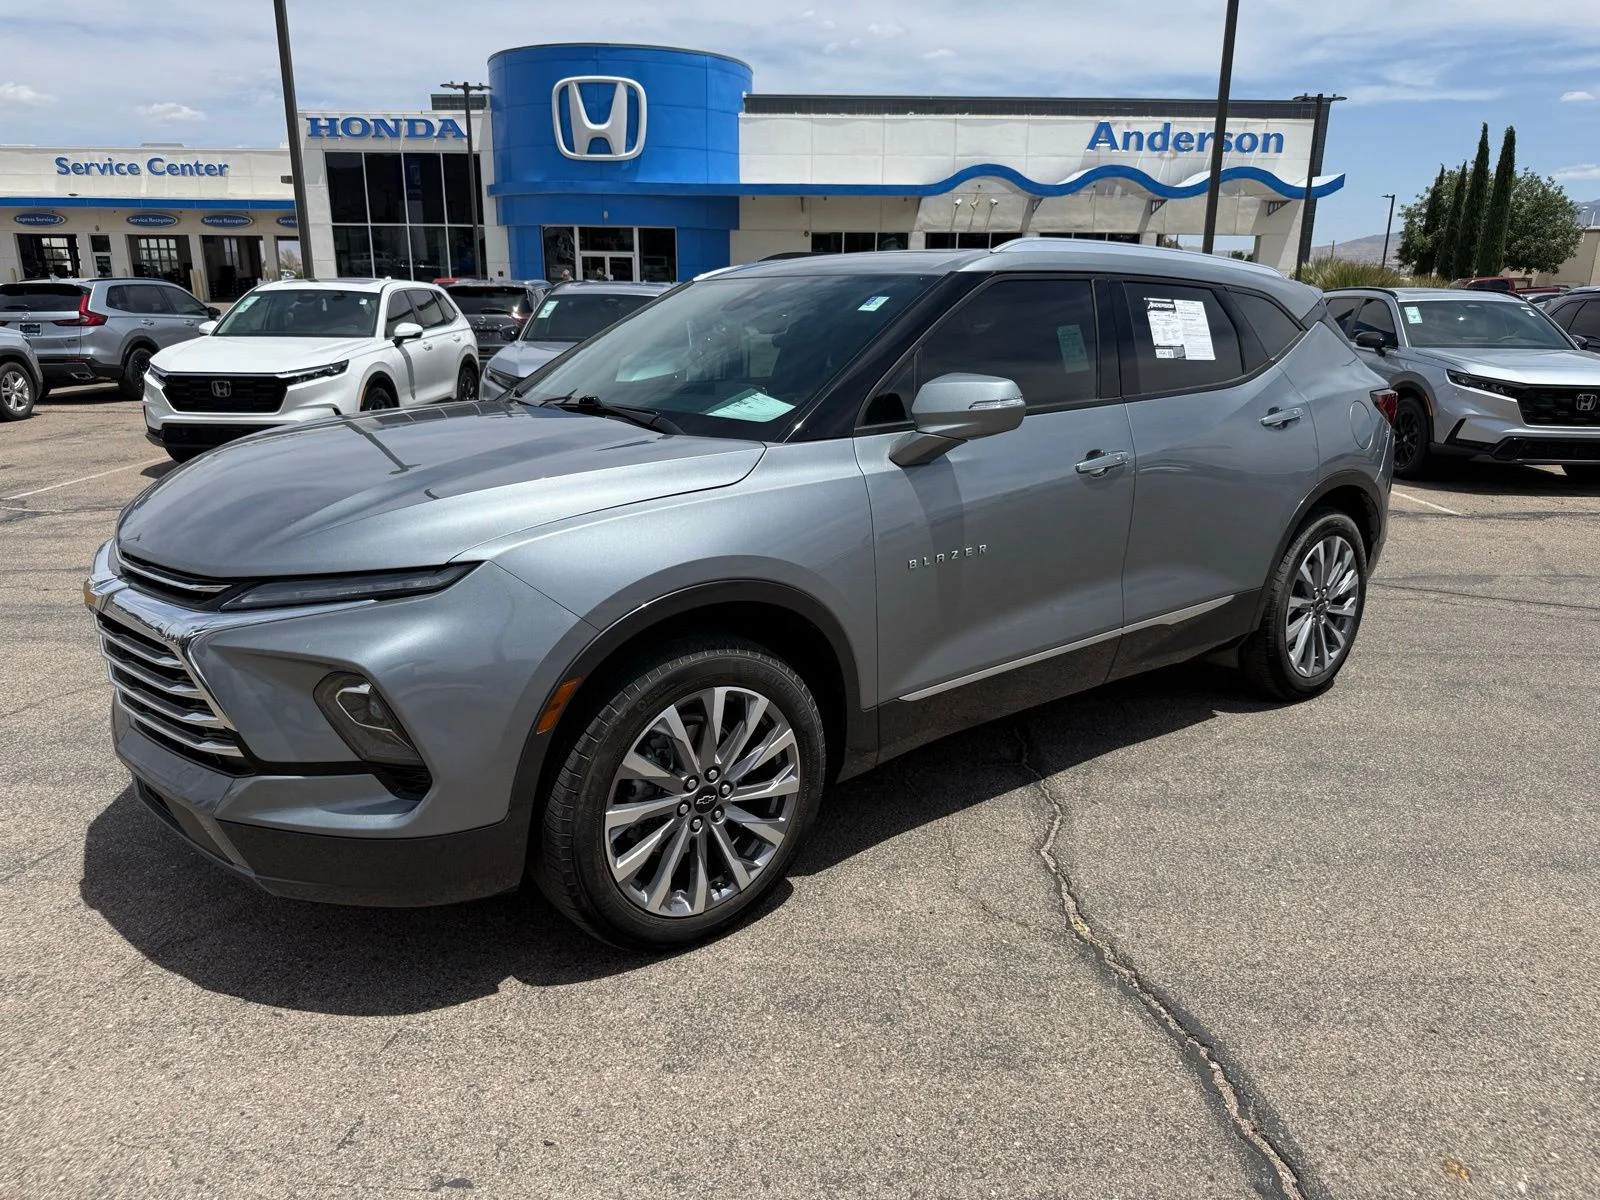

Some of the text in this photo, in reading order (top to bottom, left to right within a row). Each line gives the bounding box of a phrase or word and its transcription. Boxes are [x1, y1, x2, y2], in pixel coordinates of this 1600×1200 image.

[306, 116, 468, 139] HONDA
[1086, 120, 1284, 153] Anderson
[55, 156, 229, 177] Service Center
[908, 544, 987, 569] BLAZER
